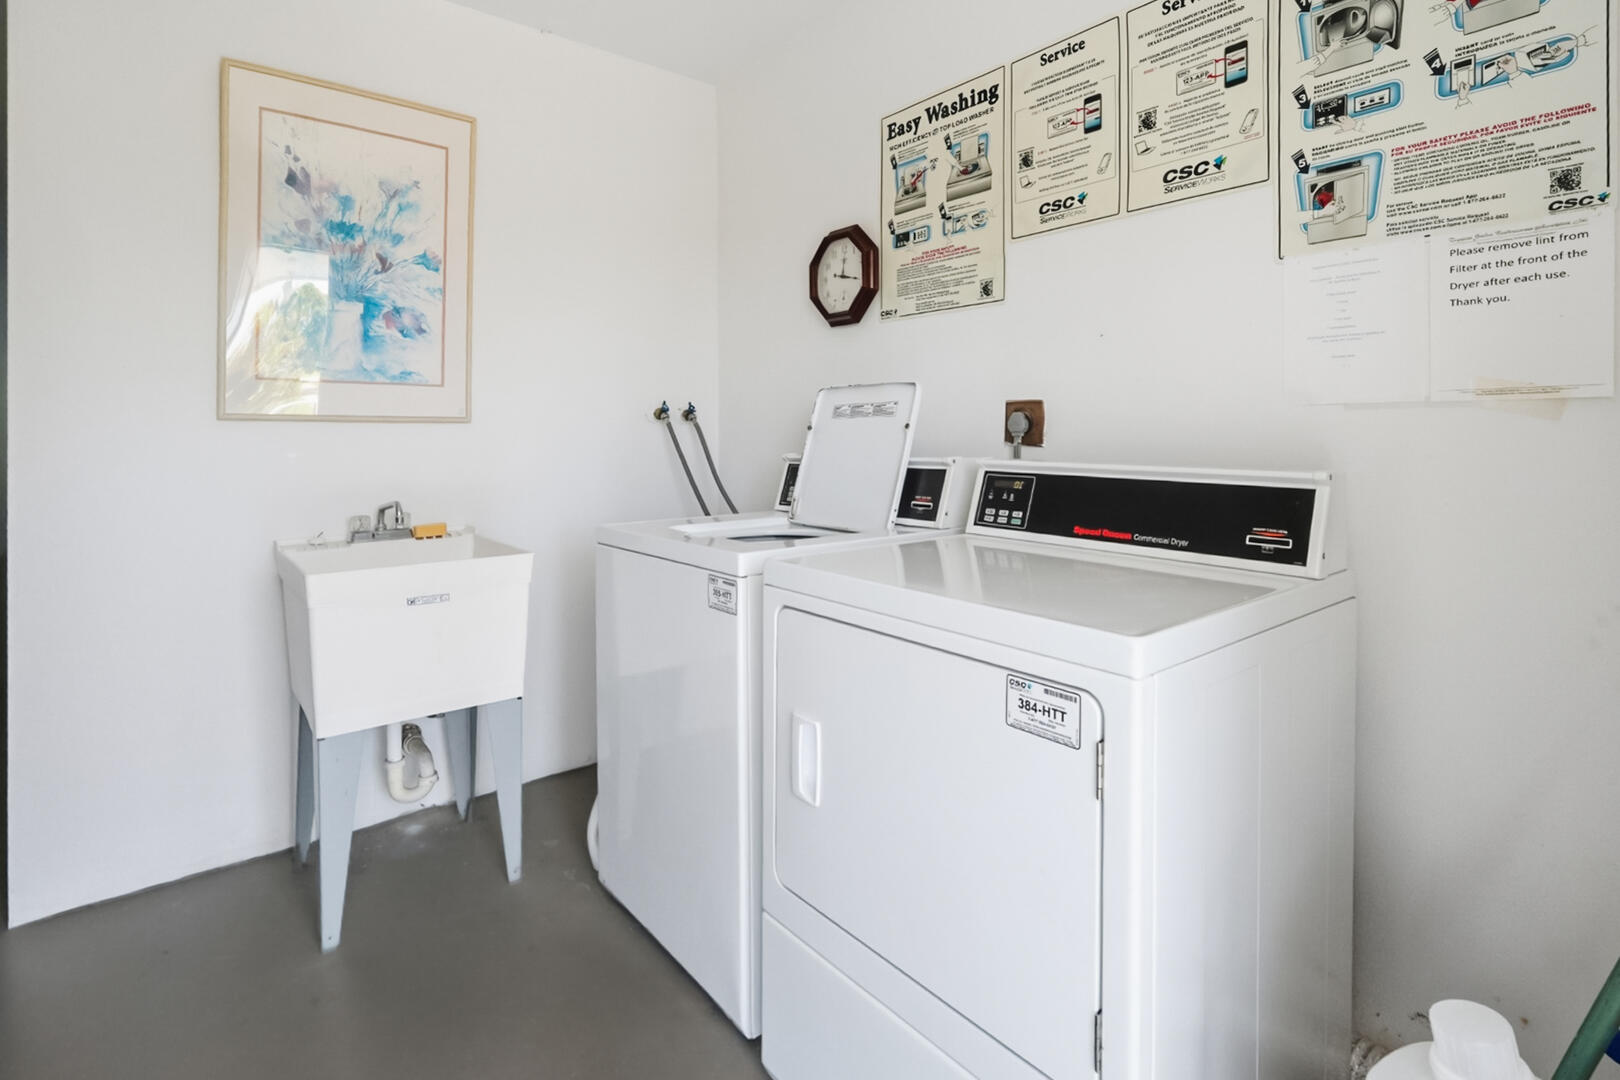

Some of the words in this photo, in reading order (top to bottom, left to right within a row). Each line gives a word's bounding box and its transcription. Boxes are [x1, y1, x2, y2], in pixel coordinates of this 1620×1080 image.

[1039, 40, 1086, 67] Service
[1430, 59, 1440, 69] 4
[1298, 94, 1306, 103] 3
[886, 116, 922, 141] Easy
[924, 83, 999, 124] Washing
[1408, 141, 1427, 149] YOUR
[1430, 134, 1458, 144] SAFETY
[1460, 127, 1489, 137] PLEASE
[1492, 121, 1517, 130] AVOID
[1520, 116, 1536, 124] THE
[1539, 103, 1591, 119] FOLLOWING
[1162, 160, 1210, 184] CSC
[1038, 196, 1076, 215] CSC
[1548, 195, 1595, 211] CSC
[1449, 246, 1485, 258] Please
[1488, 240, 1533, 253] remove
[1535, 235, 1556, 246] lint
[1559, 231, 1589, 243] from
[1449, 262, 1478, 274] Filter
[1480, 261, 1493, 270] at
[1495, 257, 1515, 269] the
[1517, 253, 1548, 266] front
[1551, 250, 1564, 261] of
[1567, 248, 1589, 260] the
[1449, 279, 1480, 292] Dryer
[1483, 275, 1511, 288] after
[1513, 271, 1542, 284] each
[1545, 268, 1571, 280] use.
[1449, 296, 1483, 307] Thank
[1485, 293, 1511, 306] you.
[1073, 525, 1101, 536] Speed
[1133, 533, 1169, 545] Commercial
[1170, 537, 1190, 547] Dryer
[1017, 697, 1068, 723] 384-HTT
